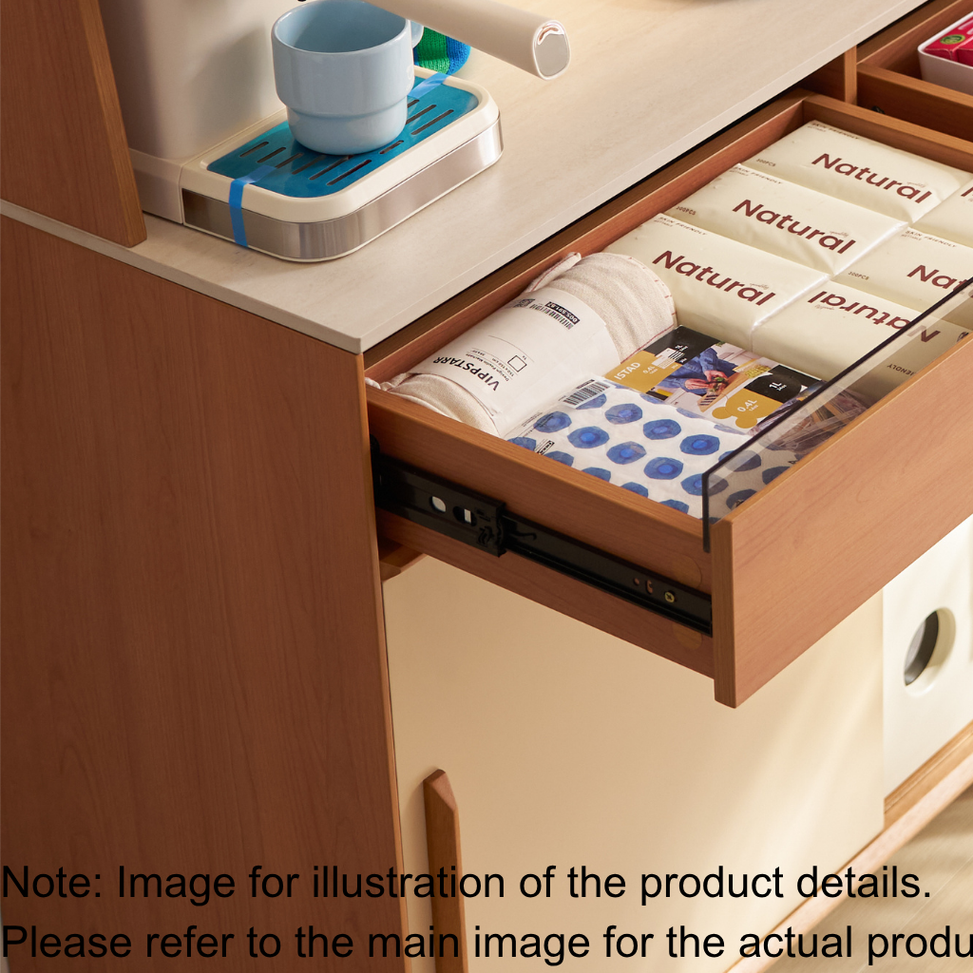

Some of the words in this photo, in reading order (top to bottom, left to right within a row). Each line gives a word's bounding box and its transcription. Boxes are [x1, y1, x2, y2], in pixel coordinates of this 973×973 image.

[811, 153, 932, 204] Natural
[732, 199, 856, 254] Natural
[652, 250, 776, 306] Natural
[433, 356, 500, 391] VIPPSTARR
[614, 362, 641, 380] ISTAD
[887, 363, 917, 376] IENDLY
[737, 399, 757, 412] 0.4L
